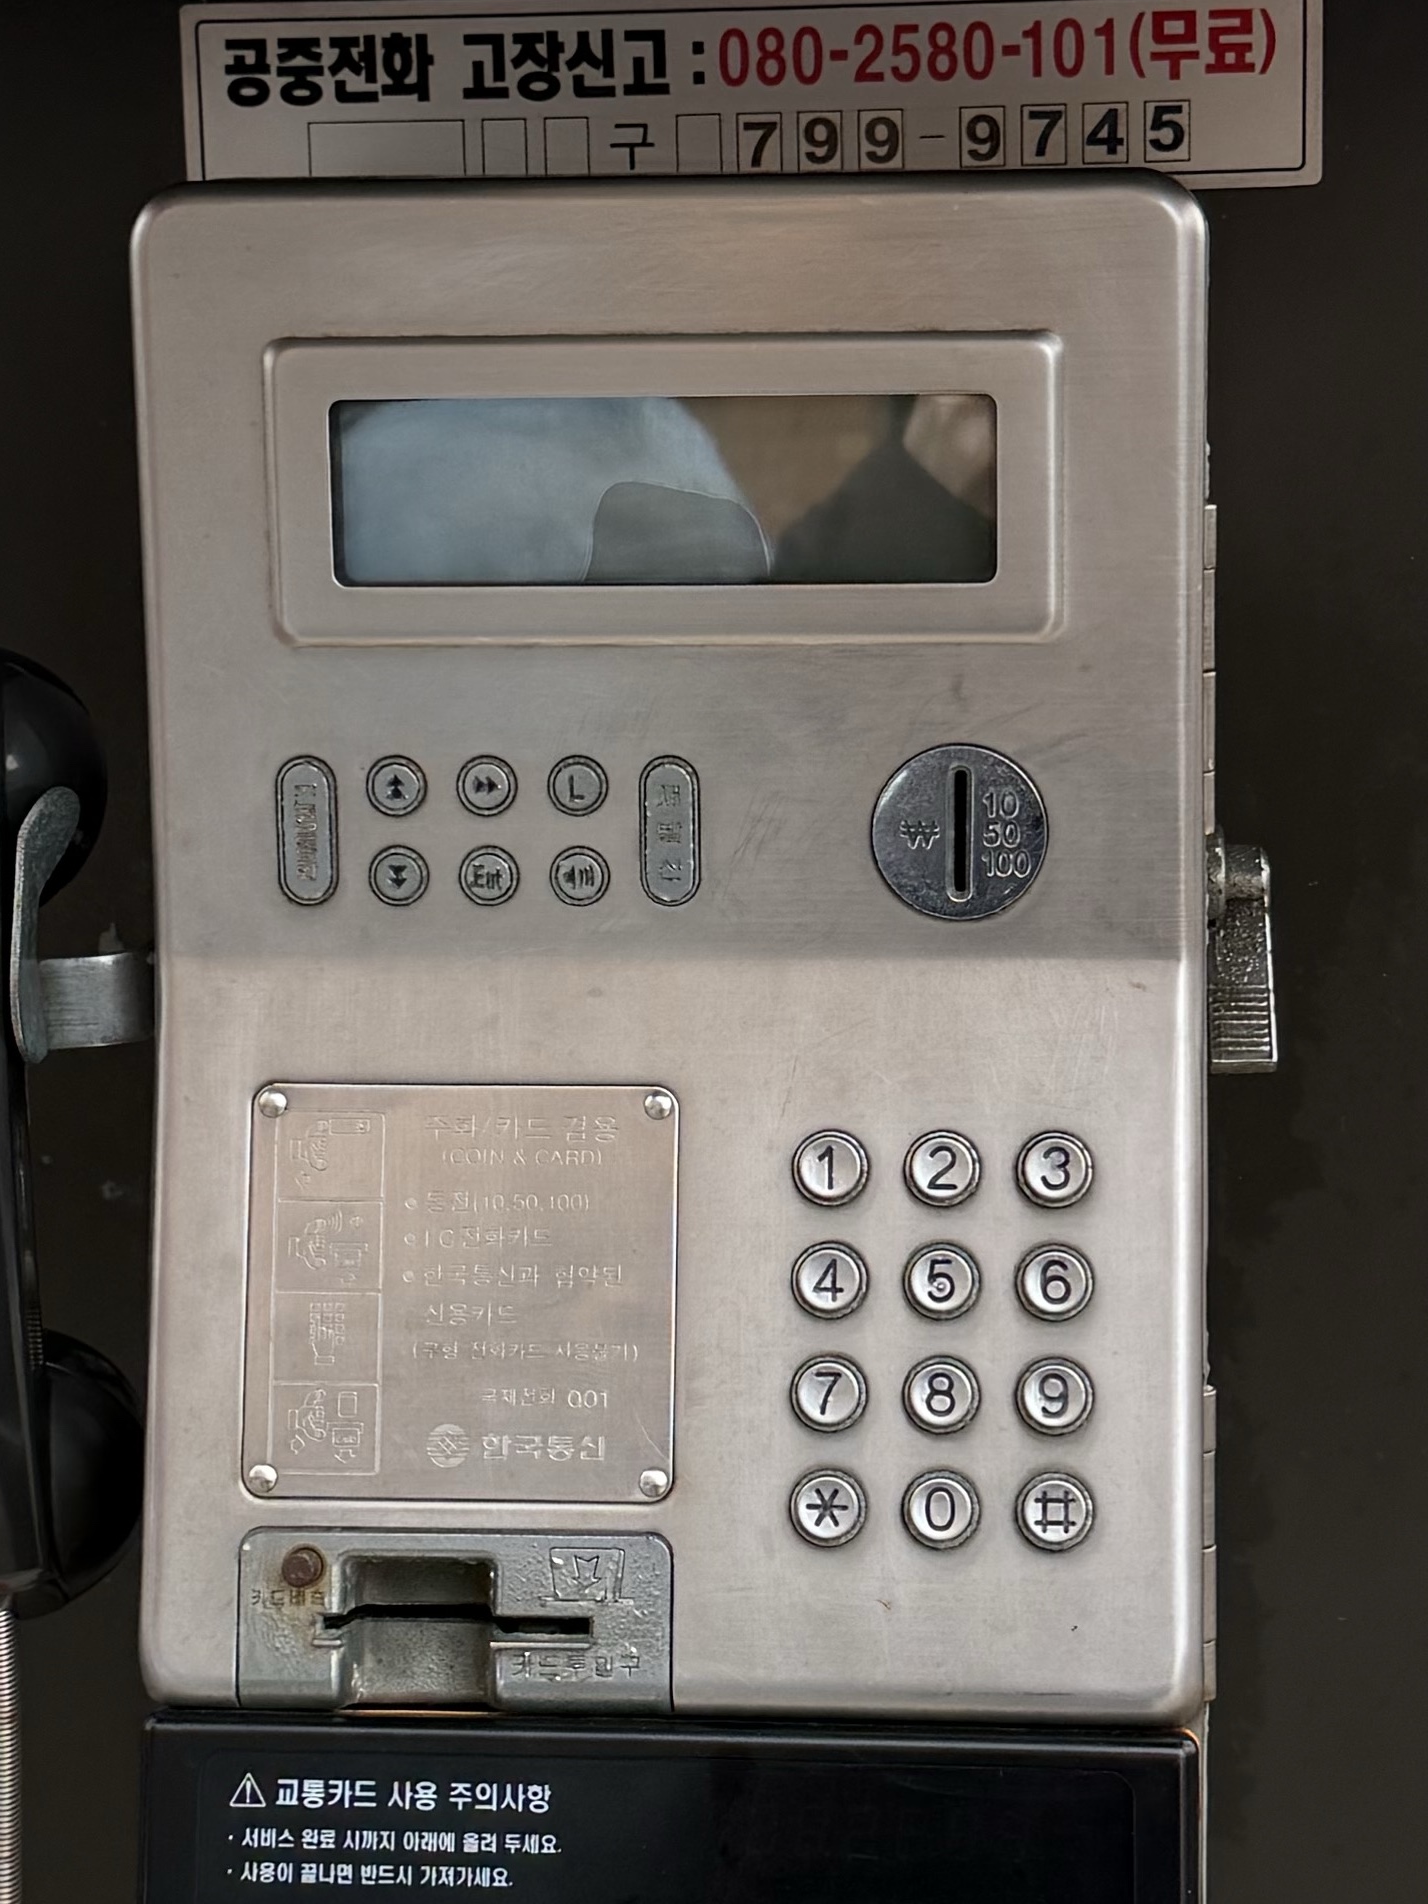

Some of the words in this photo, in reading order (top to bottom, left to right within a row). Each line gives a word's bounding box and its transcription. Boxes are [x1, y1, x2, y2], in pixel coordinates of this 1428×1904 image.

[224, 31, 435, 108] 공중전화
[609, 122, 656, 171] 구
[982, 787, 1020, 819] 10
[982, 819, 1021, 848] 50
[981, 848, 1032, 879] 100
[563, 1114, 620, 1143] 겸용
[442, 1147, 505, 1165] (COIN
[512, 1148, 527, 1165] &
[535, 1148, 602, 1166] CARD)
[817, 1144, 835, 1190] 1
[926, 1145, 958, 1191] 2
[1040, 1145, 1071, 1191] 3
[423, 1264, 539, 1288] 한국통신과
[812, 1257, 845, 1302] 4
[926, 1258, 956, 1303] 5
[1039, 1259, 1072, 1305] 6
[426, 1301, 518, 1327] 신용카드
[567, 1389, 609, 1409] 001
[814, 1371, 843, 1416] 7
[923, 1371, 956, 1418] 8
[1037, 1372, 1069, 1419] 9
[481, 1433, 606, 1462] 한국통신
[923, 1485, 956, 1532] 0
[511, 1652, 640, 1678] 카드투입구
[275, 1778, 378, 1809] 교통카드
[387, 1780, 438, 1811] 사용
[448, 1782, 552, 1814] 주의사항
[241, 1827, 295, 1849] 서비스
[301, 1828, 337, 1850] 완료
[343, 1830, 396, 1851] 시까지
[403, 1830, 456, 1853] 아래에
[462, 1831, 498, 1854] 올려
[504, 1833, 563, 1854] 두세요.
[240, 1861, 293, 1884] 사용이
[360, 1863, 413, 1886] 반드시
[420, 1865, 514, 1888] 가져가세요.
